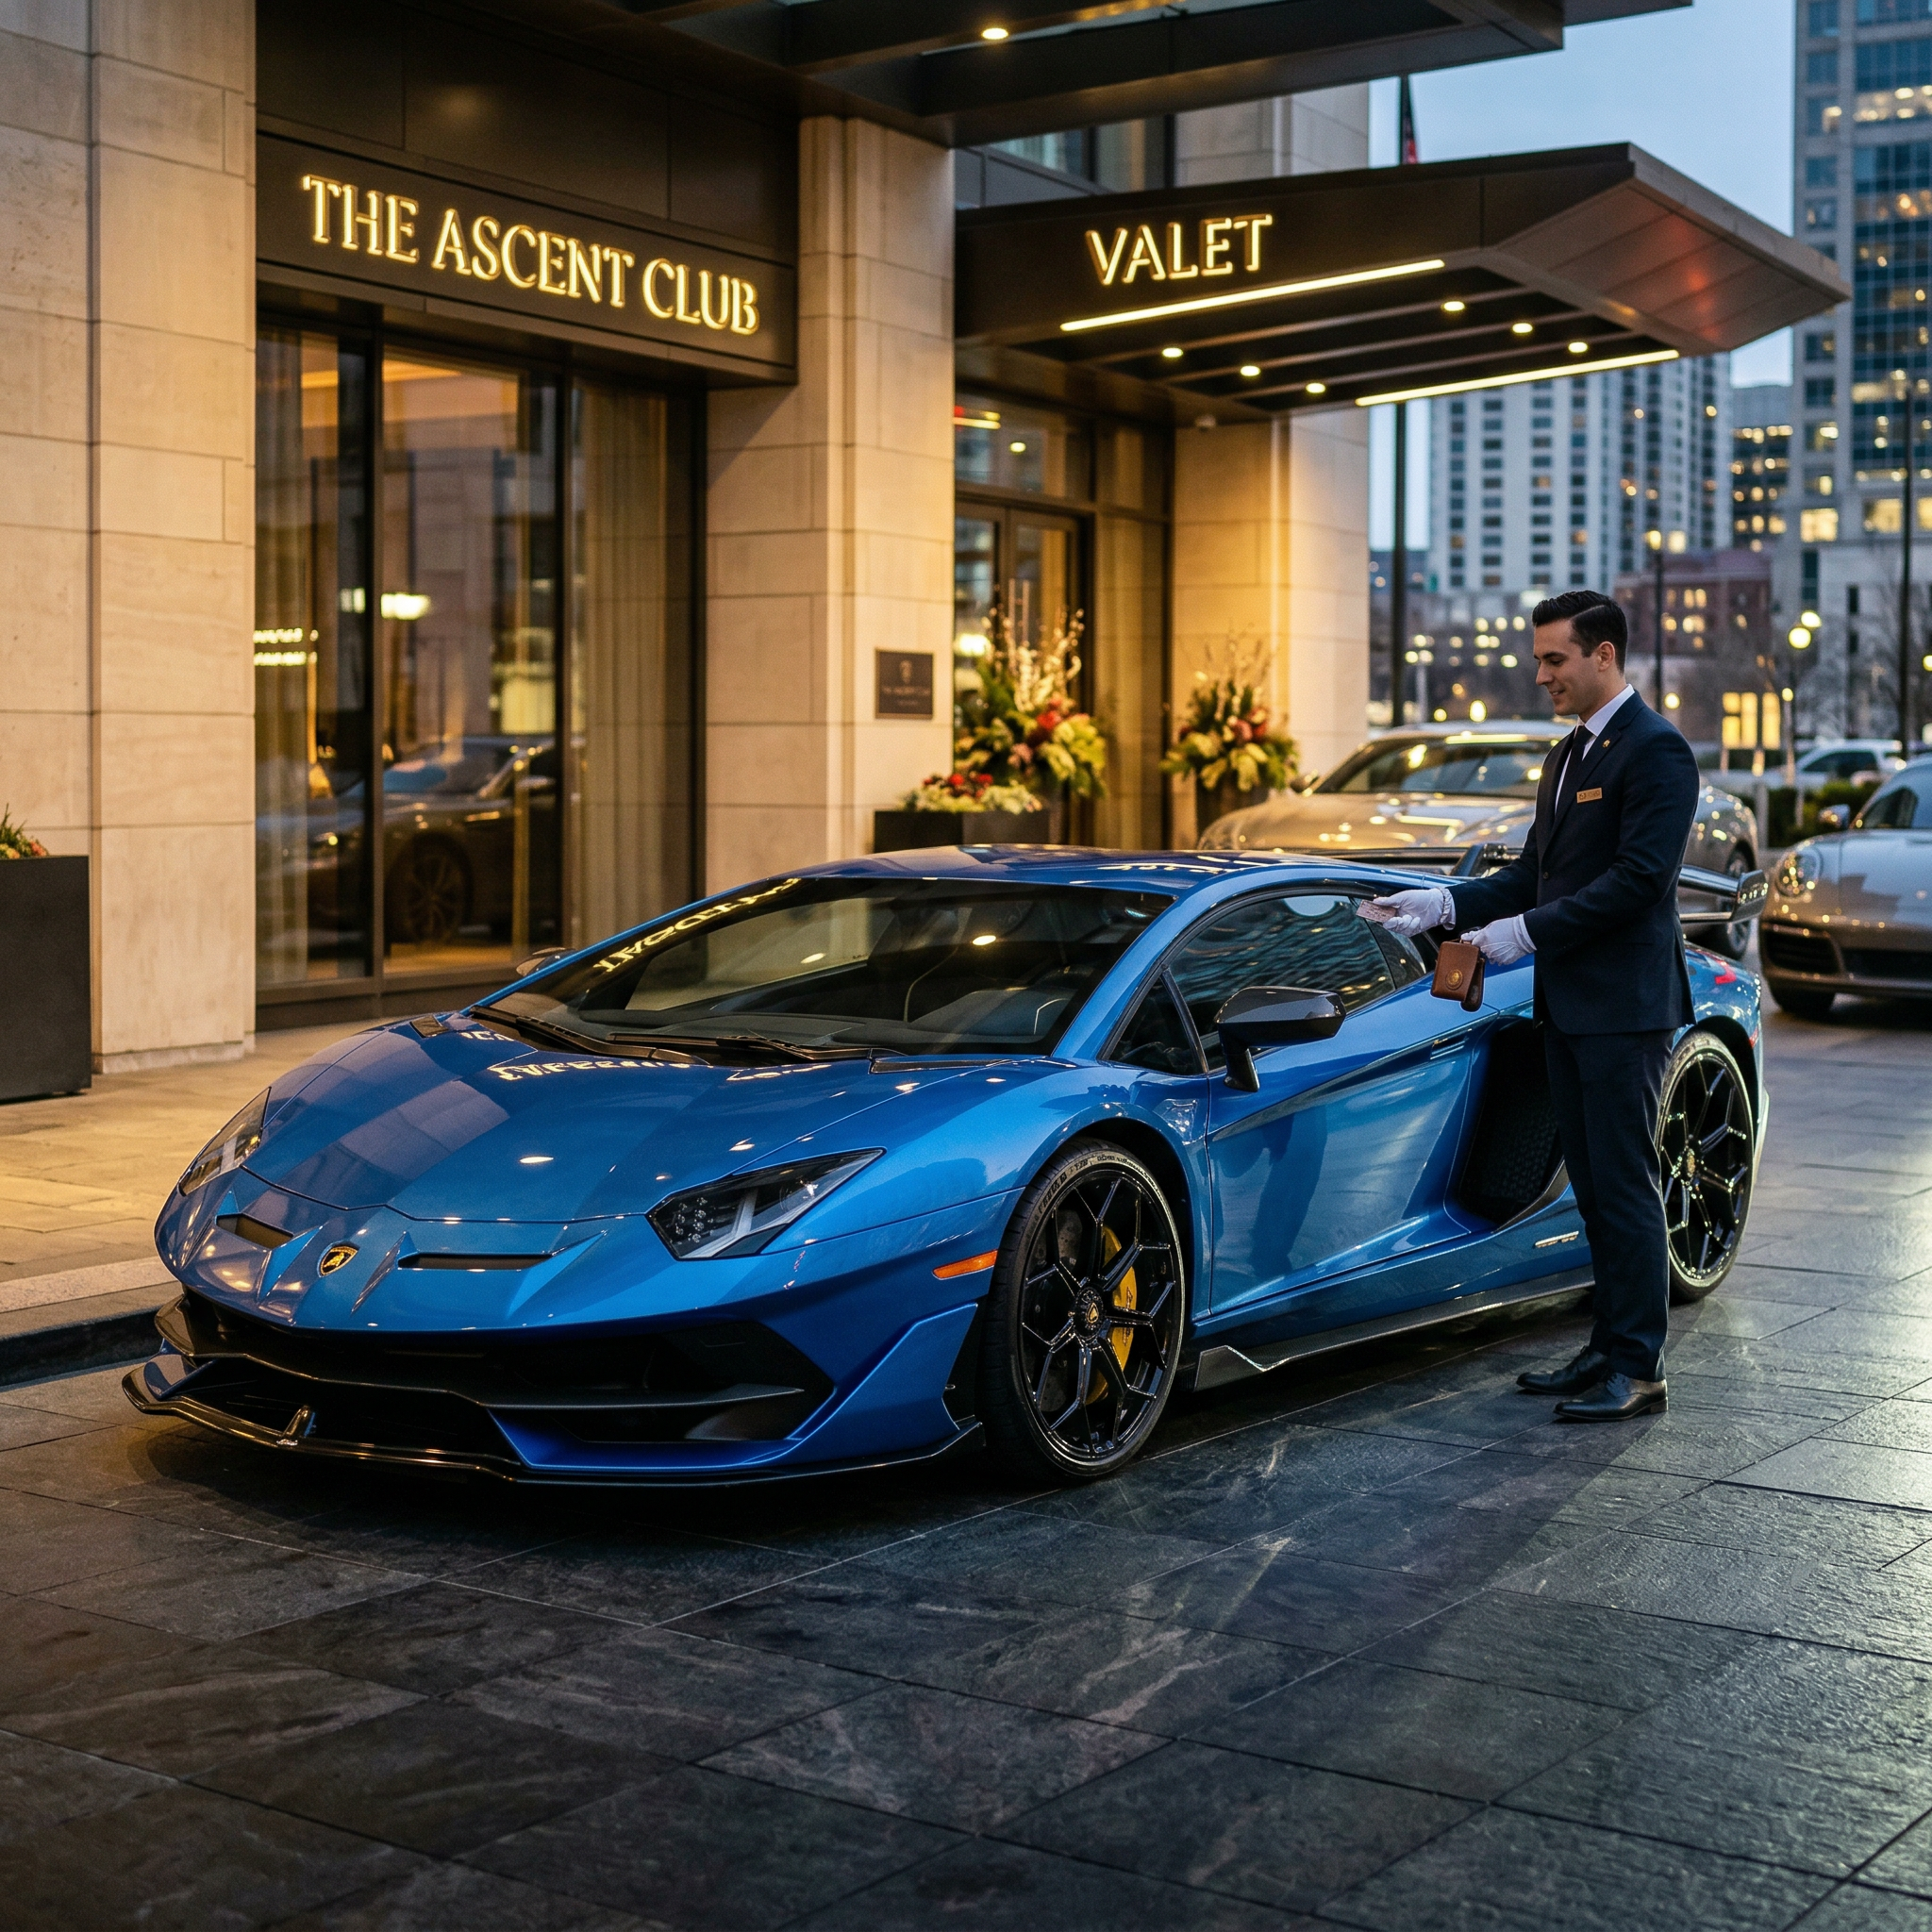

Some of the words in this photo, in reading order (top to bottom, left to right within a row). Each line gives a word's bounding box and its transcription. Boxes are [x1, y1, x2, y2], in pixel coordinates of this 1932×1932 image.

[301, 174, 419, 264] THE
[430, 208, 635, 309] ASCENT
[641, 258, 758, 336] CLUB
[1086, 213, 1273, 285] VALET
